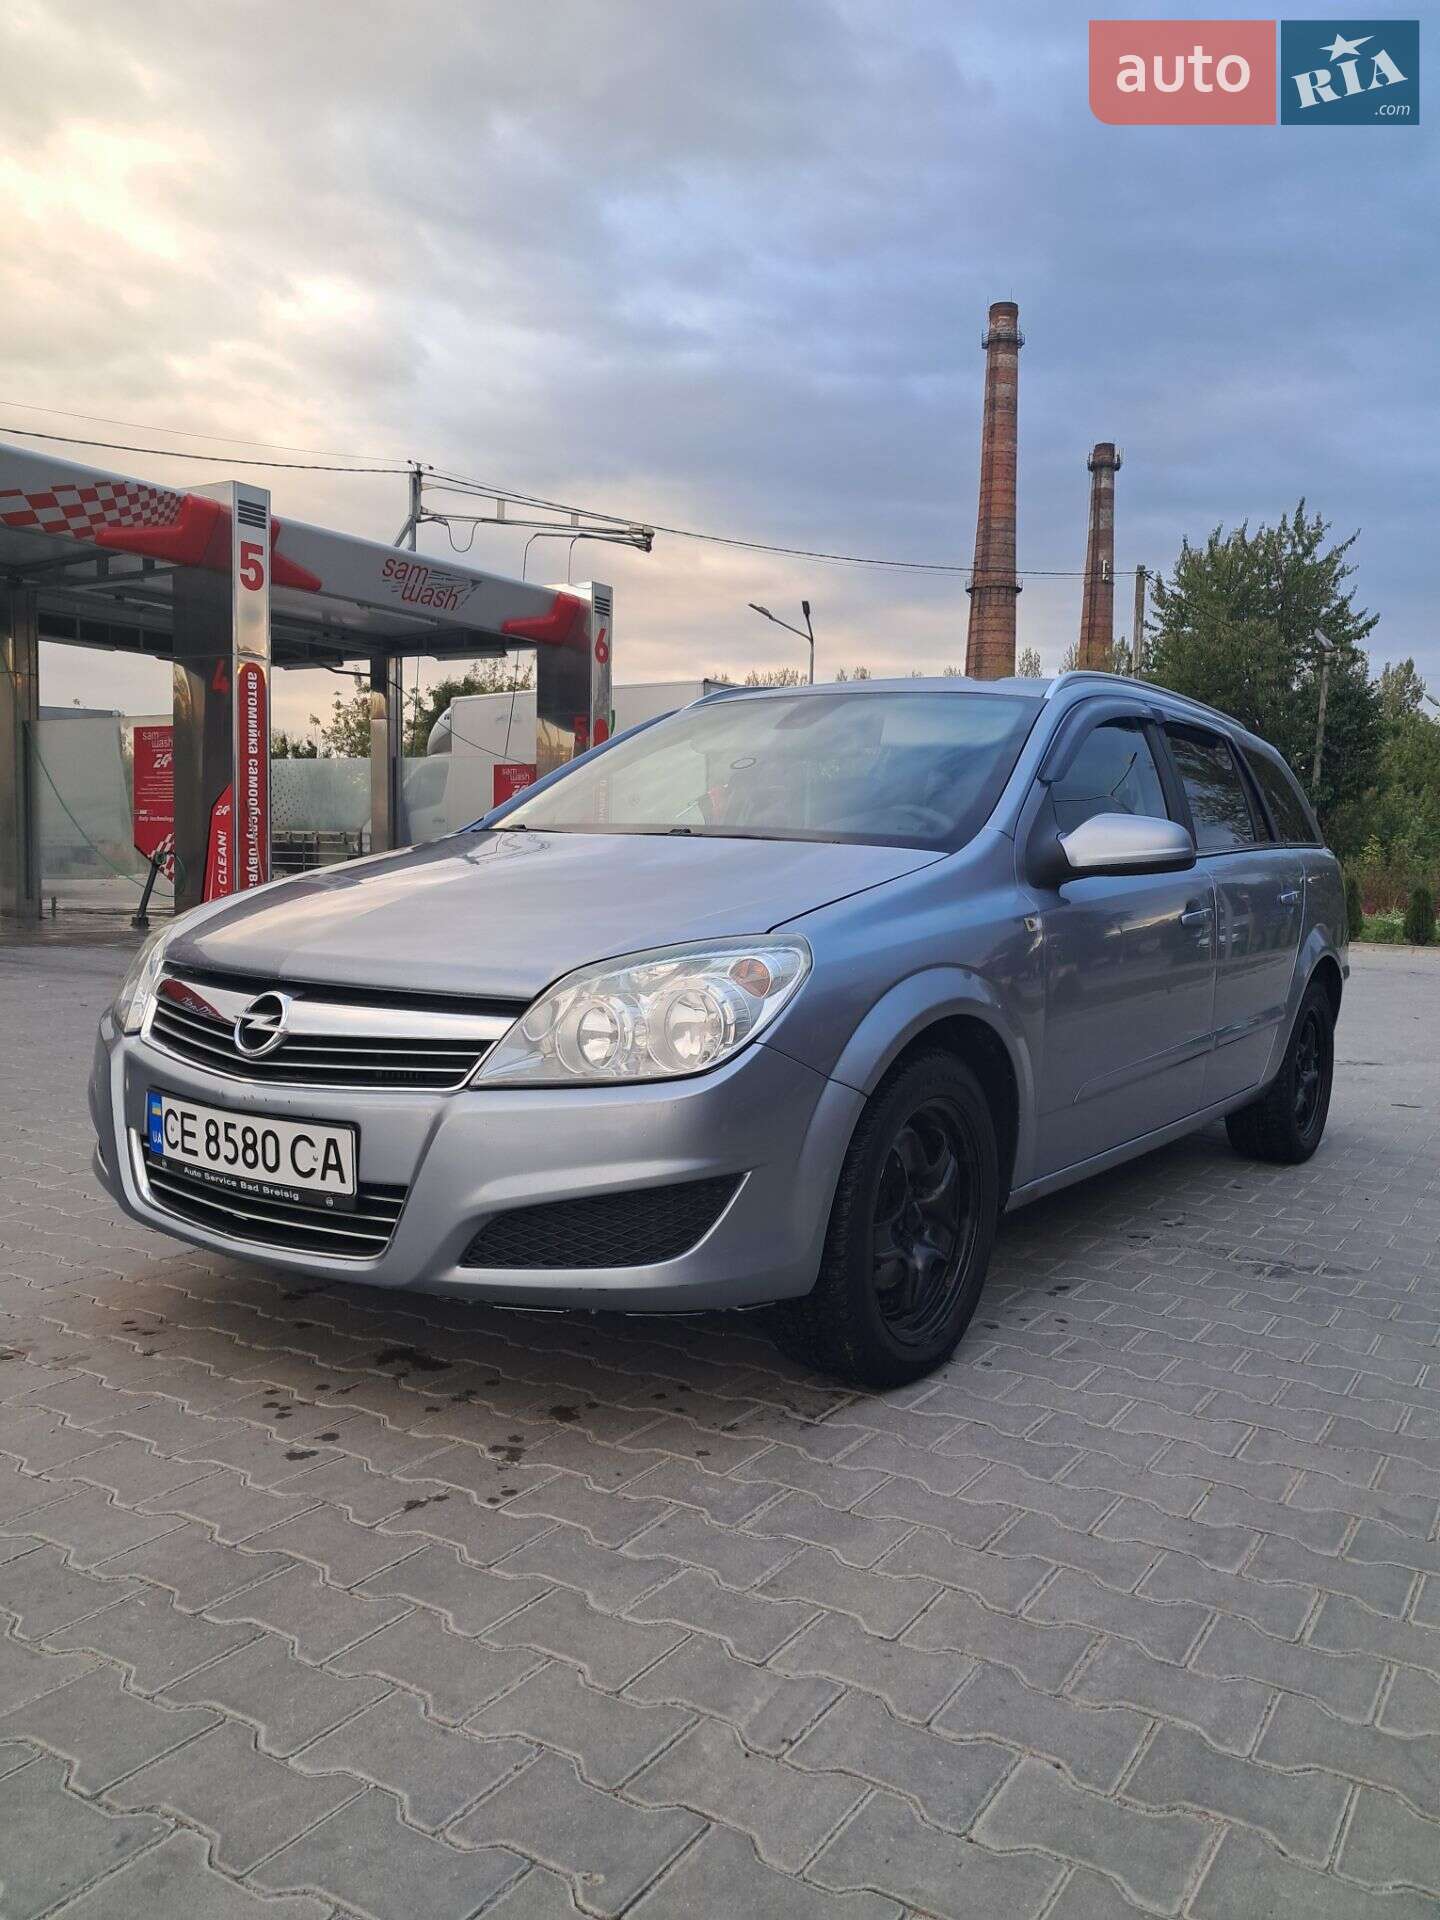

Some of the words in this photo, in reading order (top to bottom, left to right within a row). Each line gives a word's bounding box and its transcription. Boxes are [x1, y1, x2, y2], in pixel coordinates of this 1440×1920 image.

[240, 540, 264, 591] 5
[382, 558, 428, 587] sam
[401, 582, 459, 611] wash
[594, 627, 609, 664] 6
[247, 671, 261, 754] автомийка
[217, 830, 227, 884] CLEAN!
[152, 1130, 162, 1144] UA
[164, 1108, 199, 1157] CE
[205, 1118, 280, 1173] 8580
[290, 1134, 346, 1184] CA
[184, 1166, 201, 1178] Auto
[204, 1171, 237, 1188] Service
[240, 1180, 259, 1193] Bad
